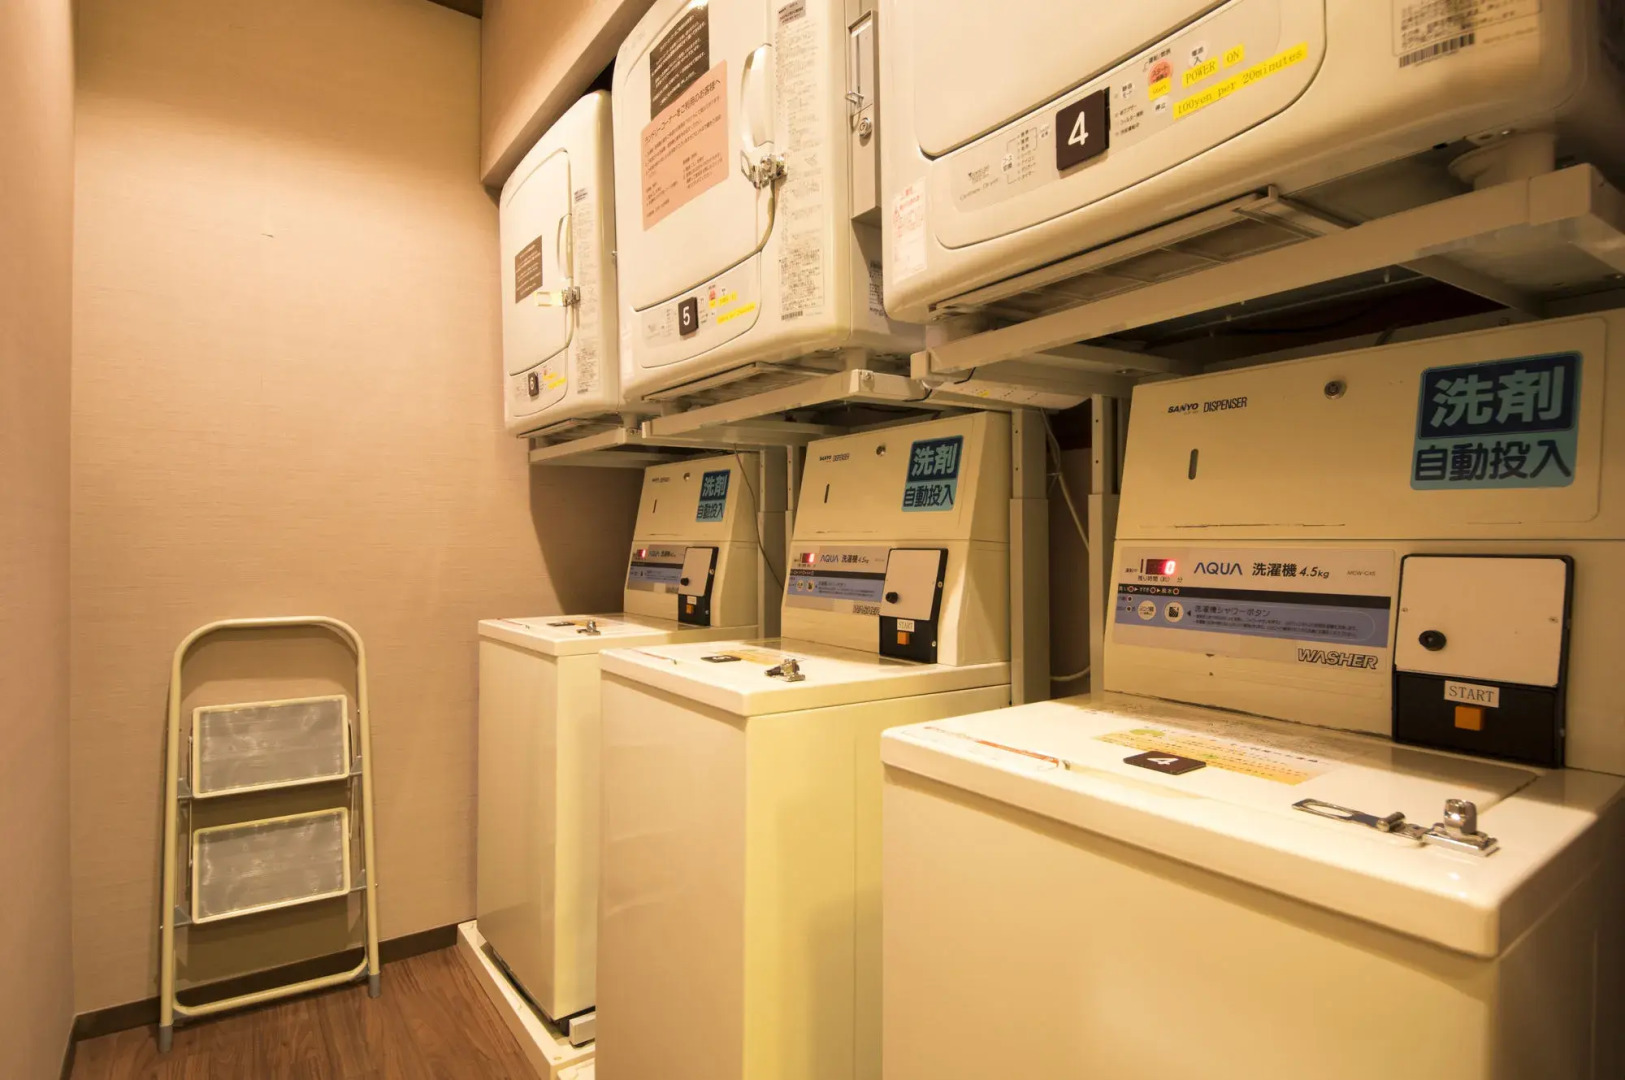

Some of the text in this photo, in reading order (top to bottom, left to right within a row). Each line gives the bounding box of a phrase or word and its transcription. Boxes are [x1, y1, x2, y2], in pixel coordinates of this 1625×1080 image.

[1185, 61, 1215, 84] POWER
[1226, 49, 1240, 64] ON
[1178, 49, 1303, 115] 100yen per 20minutes
[1068, 111, 1089, 146] 4
[683, 306, 691, 326] 5
[1168, 396, 1248, 413] SANYO DISPENSER
[1429, 366, 1565, 429] 洗剤
[911, 442, 958, 477] 洗剤
[1415, 438, 1572, 482] 自動投入
[702, 474, 727, 498] 洗剤
[903, 484, 954, 508] 自動投入
[697, 502, 723, 520] 自動投入
[1164, 560, 1176, 575] 0
[1194, 562, 1330, 580] AQUA 洗濯機 4.5kg
[1297, 648, 1378, 669] WASHER
[1448, 685, 1495, 704] START
[1146, 756, 1180, 766] 4
